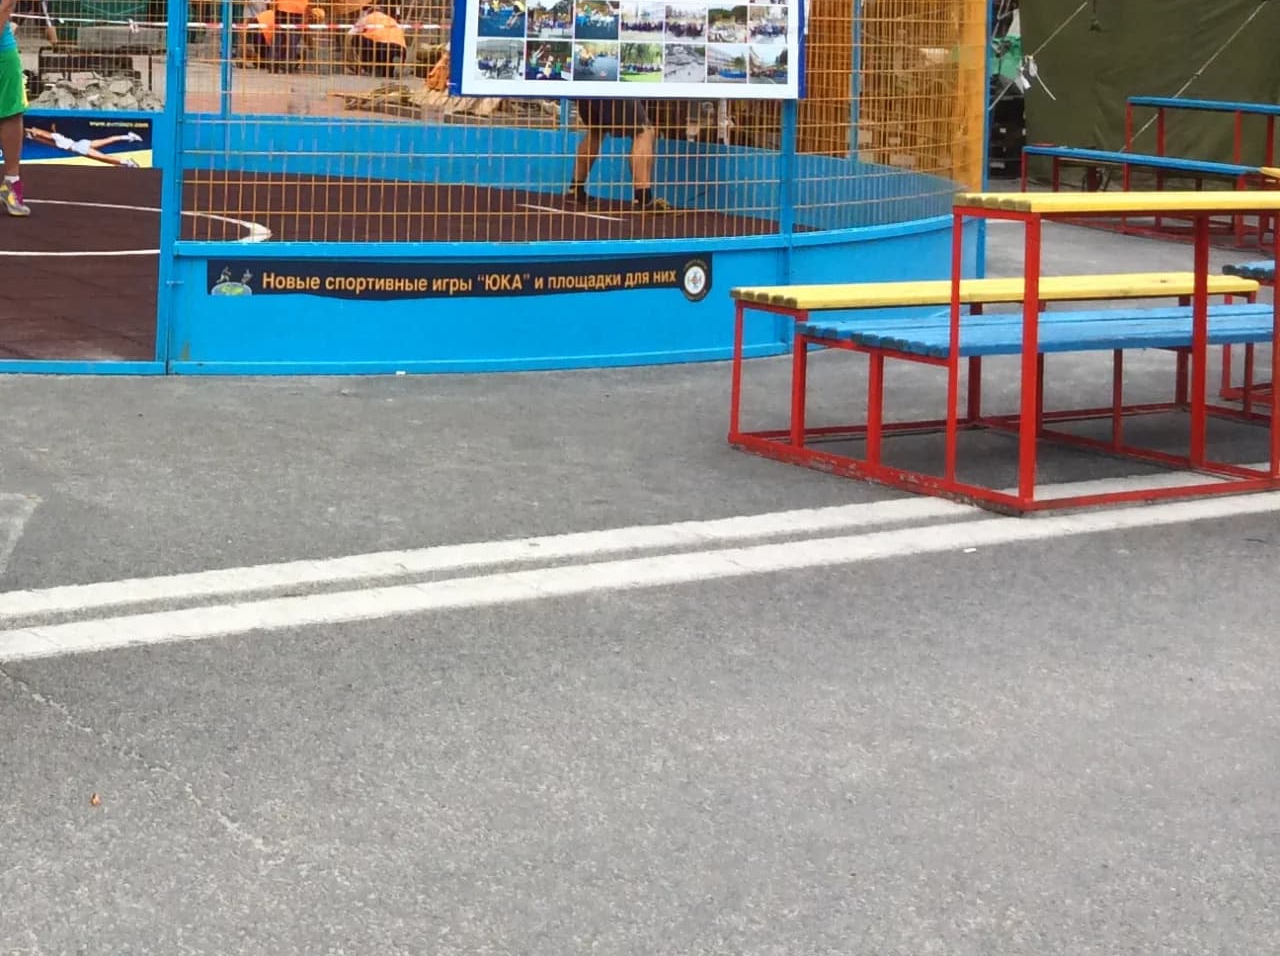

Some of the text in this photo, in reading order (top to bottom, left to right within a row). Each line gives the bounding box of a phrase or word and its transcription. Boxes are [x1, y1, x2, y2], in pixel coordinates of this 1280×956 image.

[262, 272, 320, 290] Новые
[325, 276, 427, 294] спортивные
[432, 277, 472, 295] игры
[534, 278, 544, 289] и
[548, 271, 621, 290] площадки
[624, 270, 650, 287] для
[653, 269, 677, 283] них
